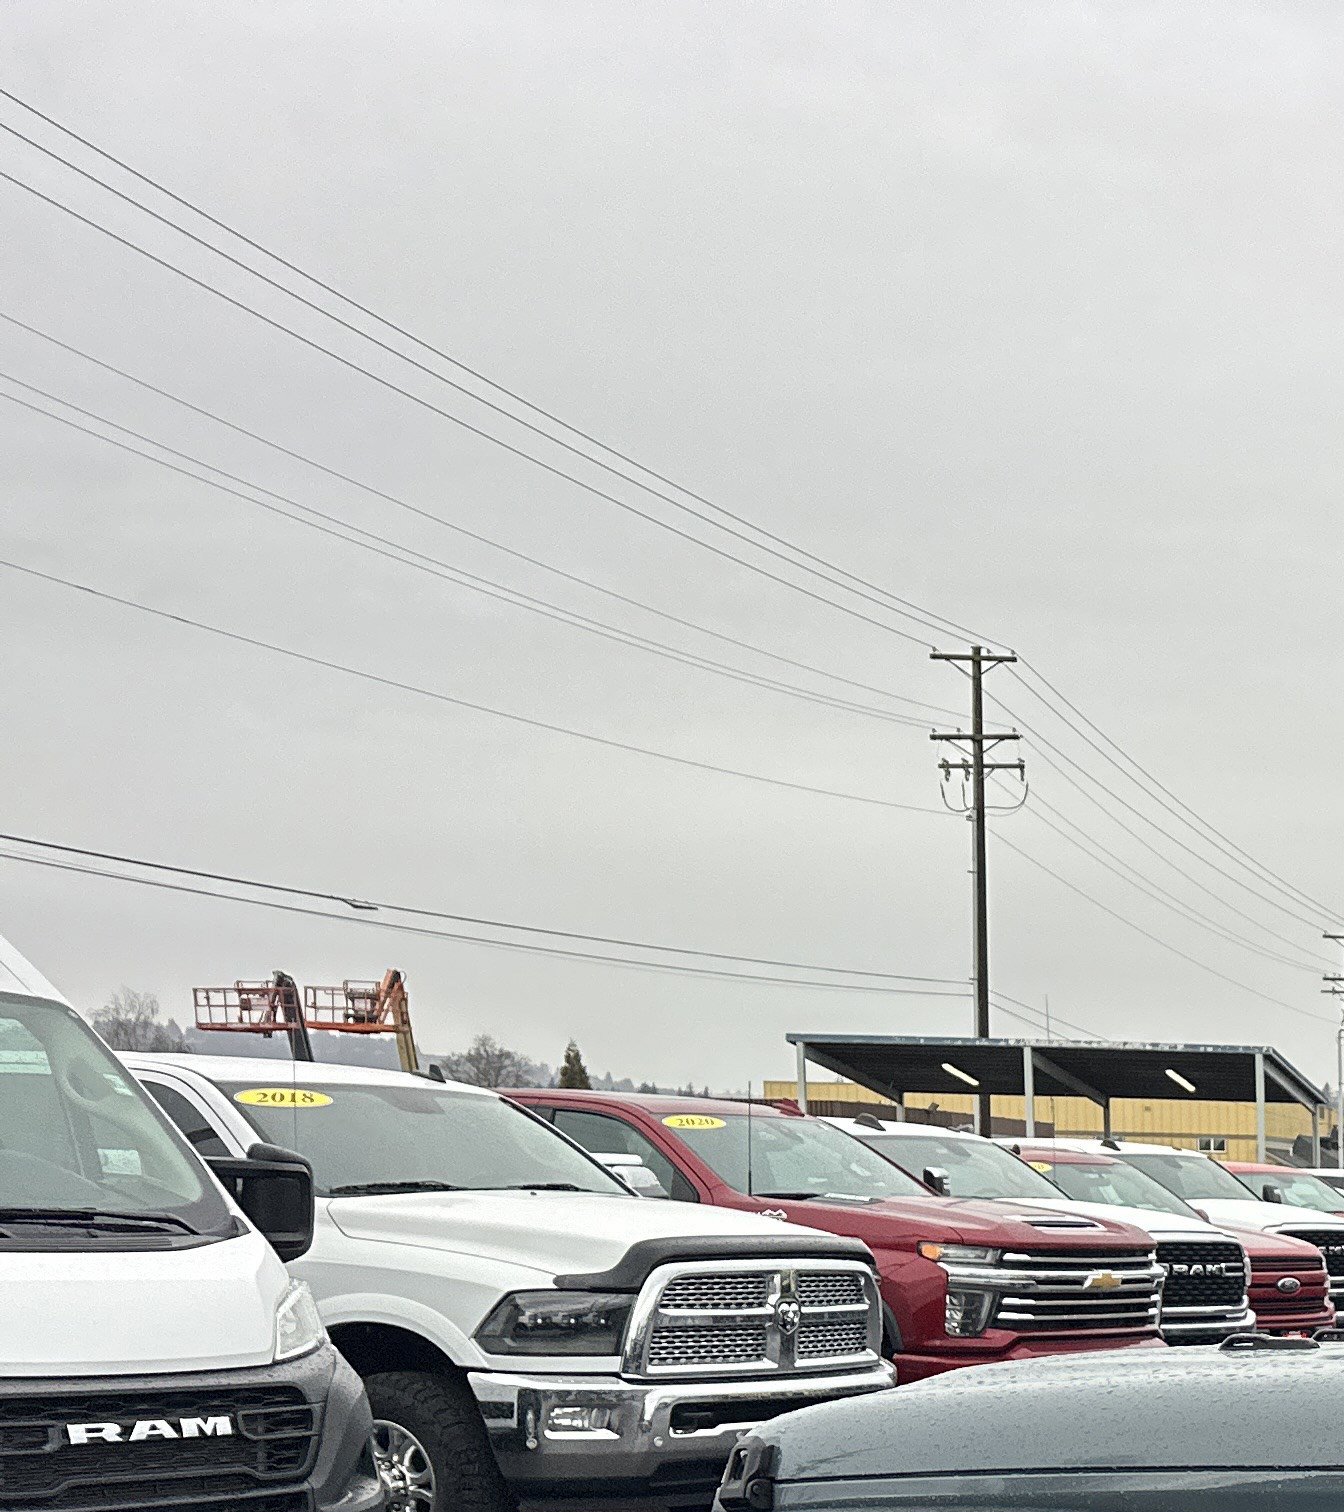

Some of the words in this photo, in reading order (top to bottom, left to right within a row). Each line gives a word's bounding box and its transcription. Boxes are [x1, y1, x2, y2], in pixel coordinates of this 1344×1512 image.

[256, 1092, 315, 1103] 2018
[1172, 1263, 1223, 1276] RAM
[66, 1416, 233, 1445] RAM
